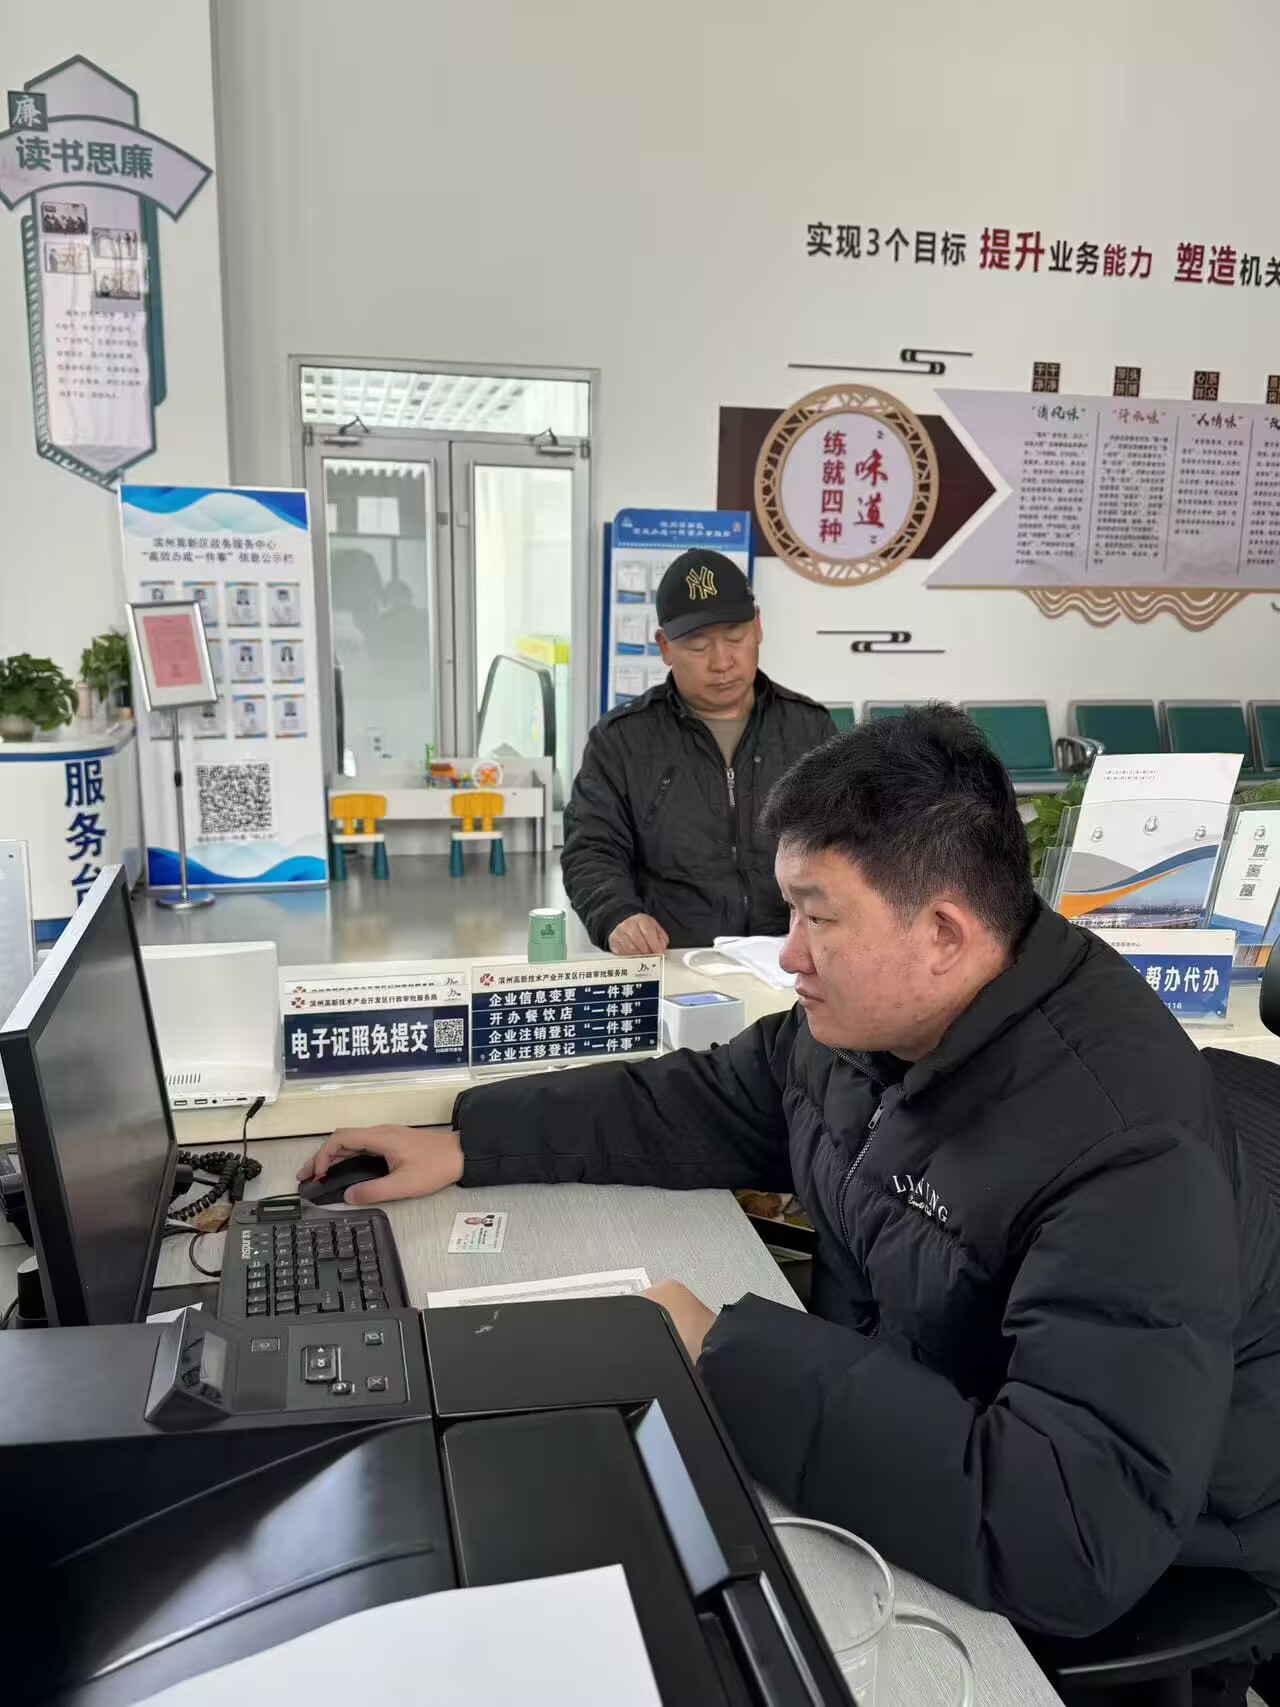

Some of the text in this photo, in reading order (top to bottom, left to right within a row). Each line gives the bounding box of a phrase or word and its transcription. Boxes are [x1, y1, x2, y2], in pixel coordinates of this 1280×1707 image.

[15, 135, 154, 179] 读书思廉
[806, 221, 967, 266] 实现3个目标
[979, 227, 1153, 279] 提升业务能力
[819, 430, 847, 544] 练就四种
[853, 448, 888, 529] 味道
[686, 566, 718, 600] NY
[498, 968, 628, 985] 滨州高新技术产业开发区行政审批服务局
[1133, 966, 1220, 993] 帮办代办
[309, 993, 438, 1007] 滨州高新技术产业开发区行政审批服务局
[489, 983, 643, 1008] 企业信息变更 “一件事”
[489, 1001, 641, 1026] 开办餐饮店 “一件事”
[291, 1021, 429, 1060] 电子证照免提交
[488, 1018, 642, 1044] 企业注销登记 “一件事”
[488, 1036, 641, 1062] 企业迁移登记 “一件事”
